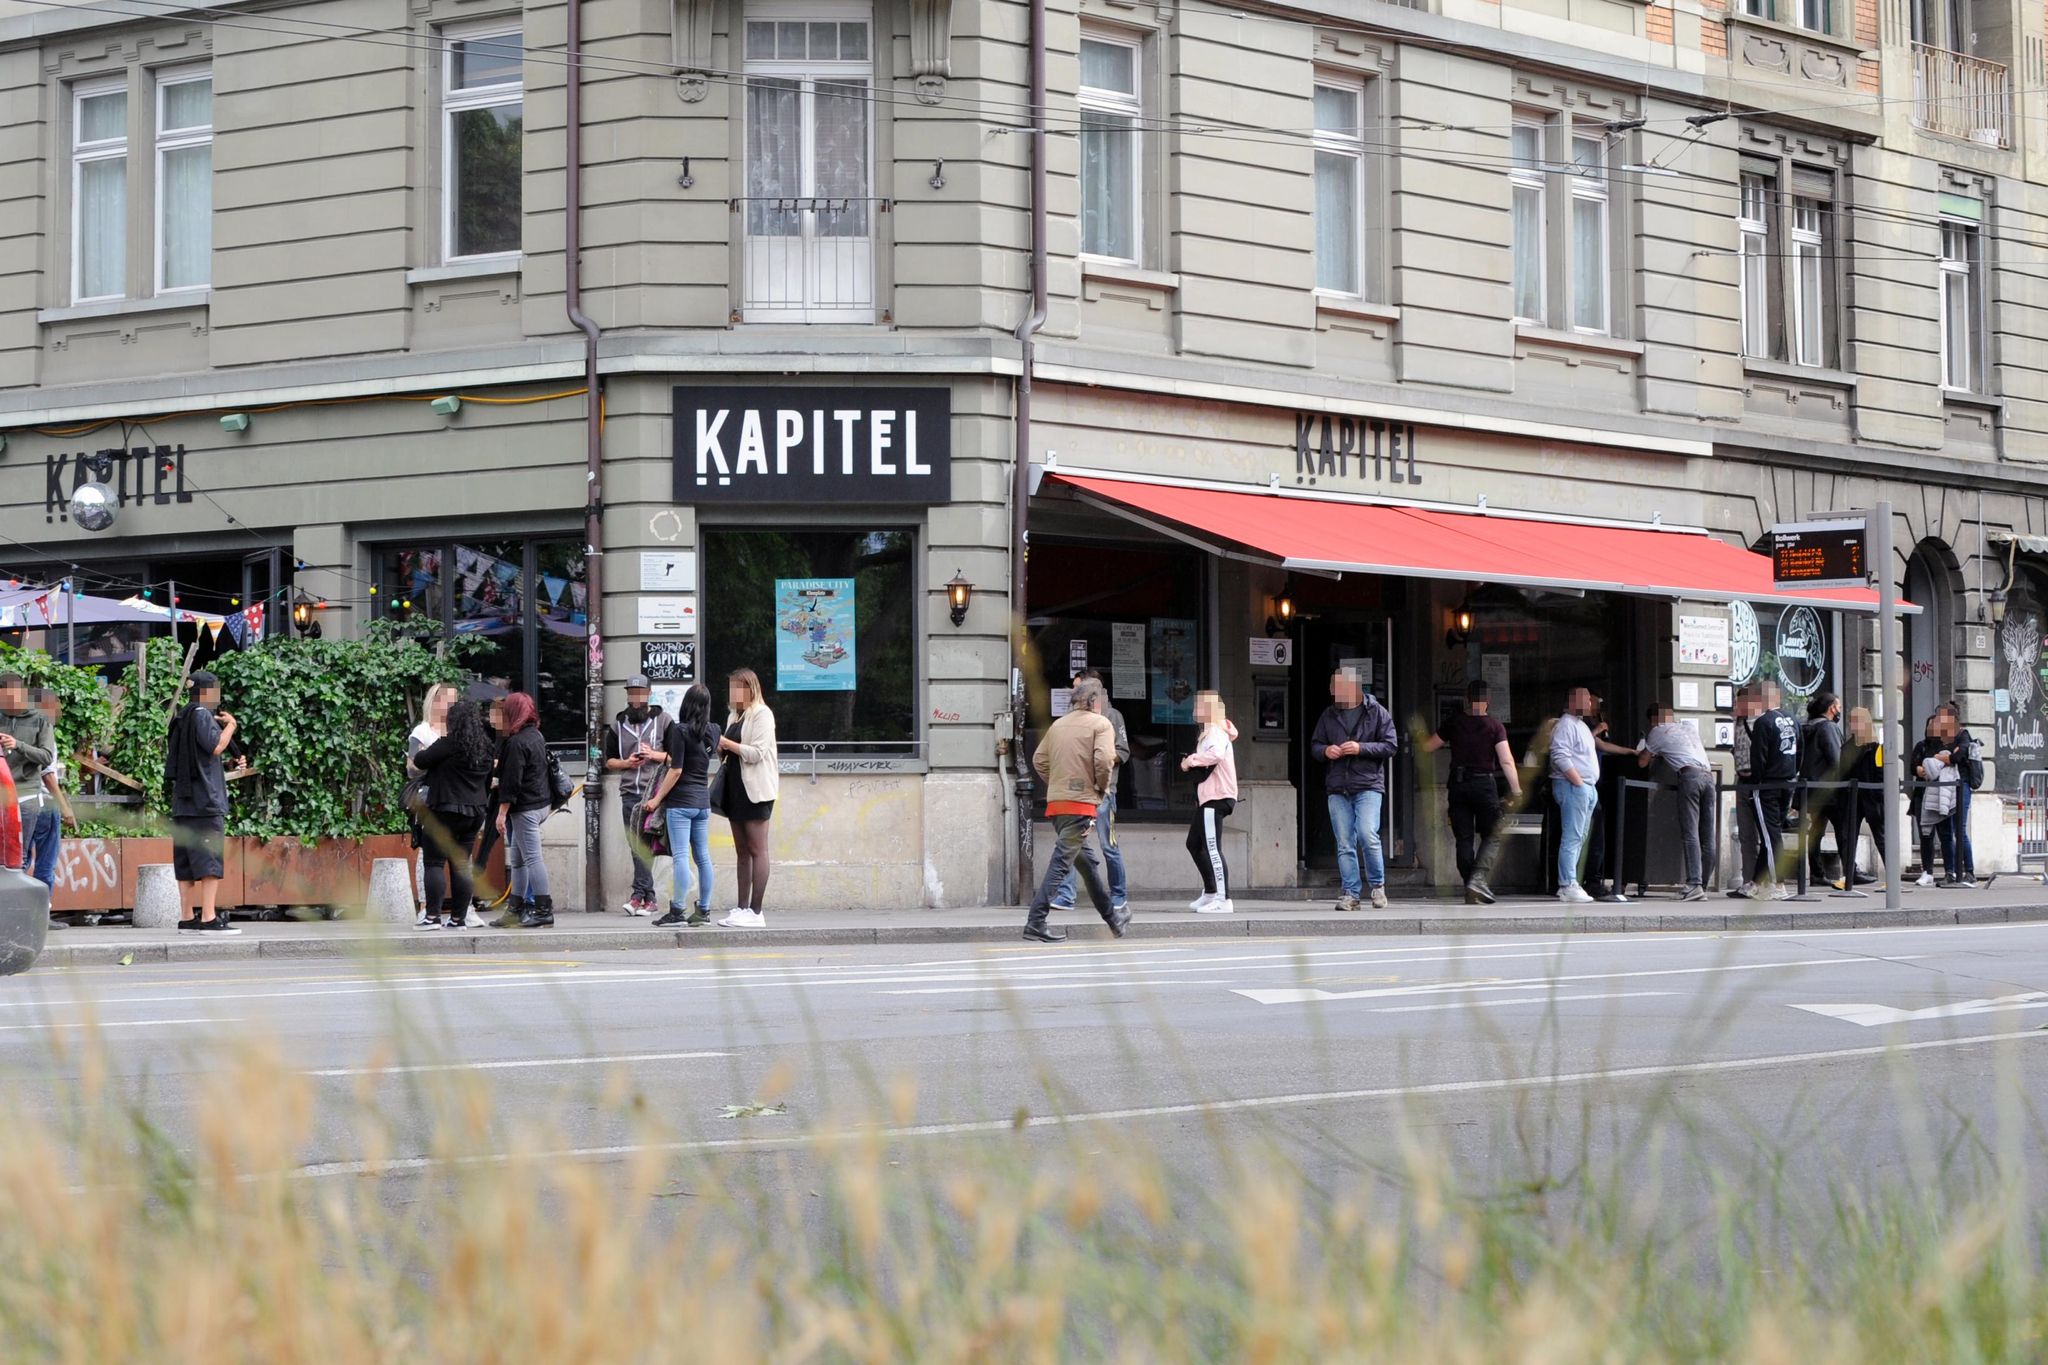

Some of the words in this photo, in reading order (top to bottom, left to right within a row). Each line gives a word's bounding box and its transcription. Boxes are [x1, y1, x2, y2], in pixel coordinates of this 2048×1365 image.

[696, 409, 932, 486] KAPITEL
[1296, 412, 1422, 485] KAPITEL
[781, 581, 826, 590] PARADISE
[828, 580, 850, 589] CITY
[2007, 715, 2045, 750] Chouette
[1207, 836, 1217, 851] TAKE
[1211, 854, 1221, 865] THE
[1214, 866, 1224, 881] RISK
